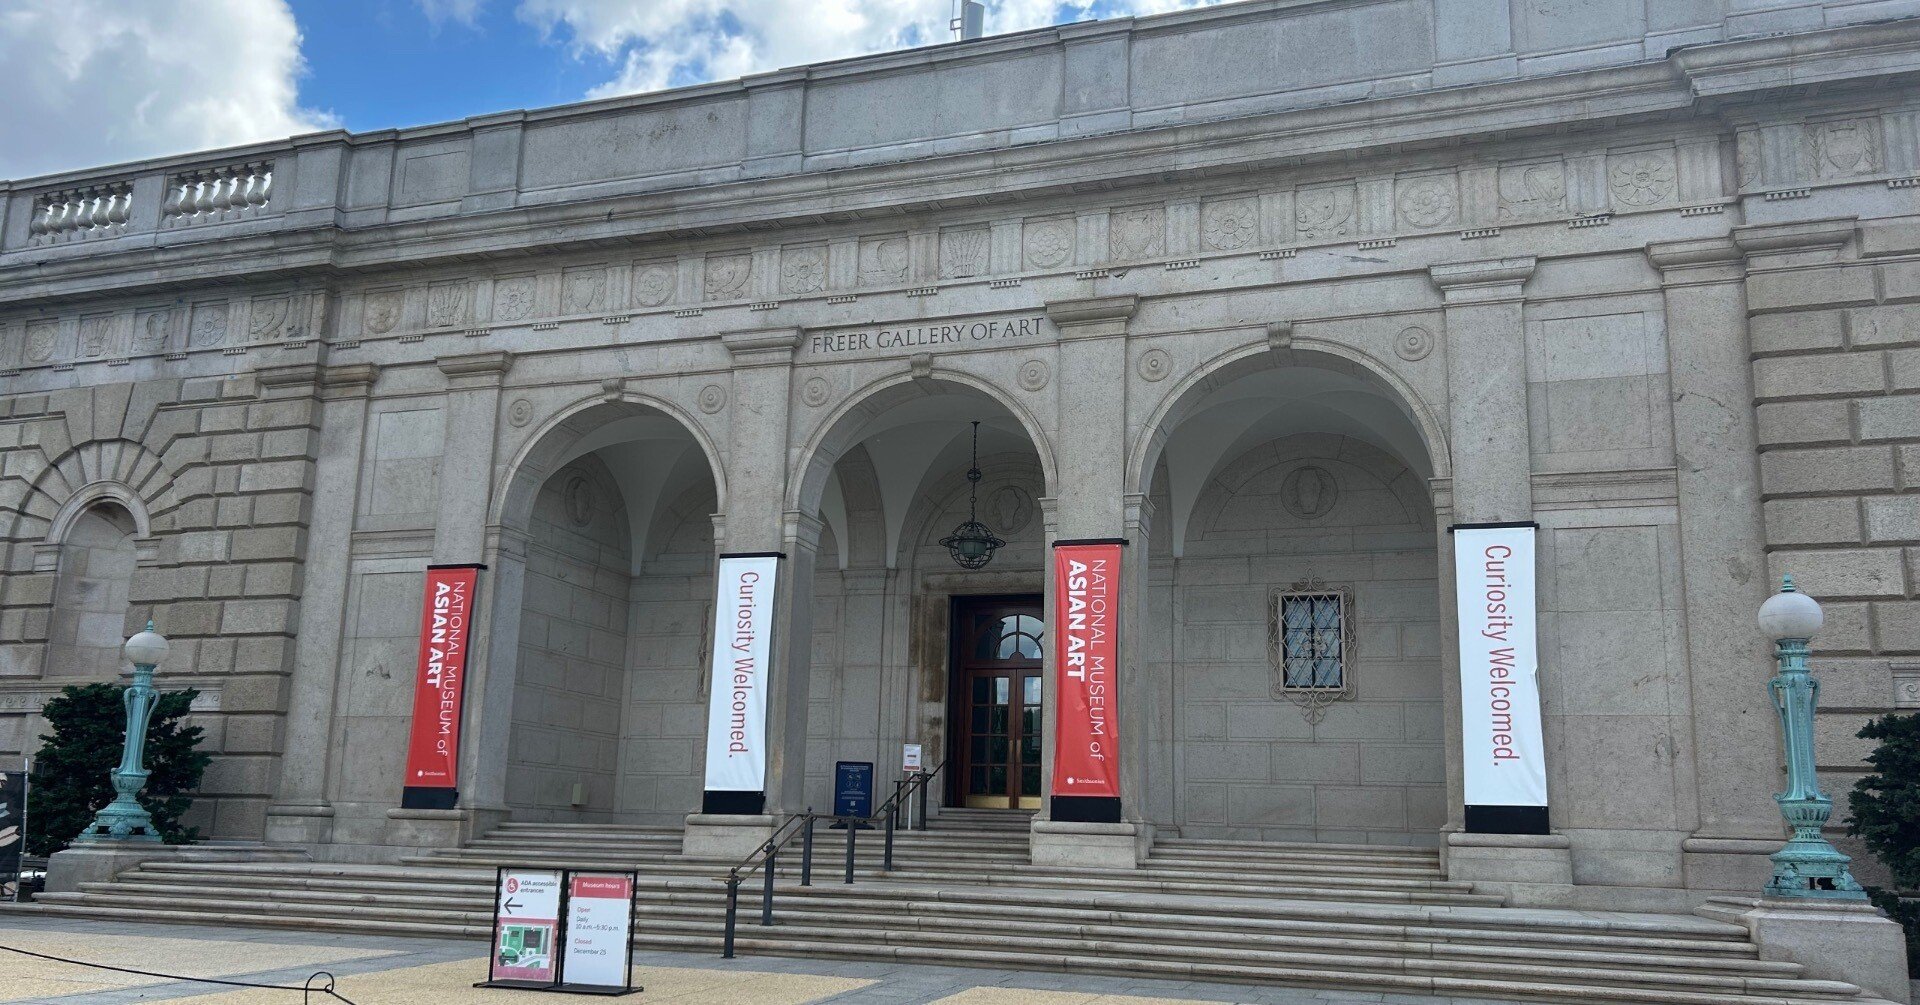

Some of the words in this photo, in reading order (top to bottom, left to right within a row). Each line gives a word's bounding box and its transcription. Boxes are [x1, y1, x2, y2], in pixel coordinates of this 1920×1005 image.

[812, 333, 871, 354] FREER
[876, 325, 966, 349] GALLERY
[970, 322, 998, 341] OF
[1002, 317, 1044, 338] ART
[431, 582, 451, 643] ASIAN
[446, 582, 466, 660] NATIONAL
[731, 572, 759, 653] Curiosity
[1068, 560, 1087, 630] ASIAN
[1090, 560, 1106, 650] NATIONAL
[1481, 545, 1513, 641] Curiosity
[427, 647, 444, 688] ART
[1067, 635, 1086, 682] ART
[438, 666, 458, 734] MUSEUM
[729, 658, 754, 758] Welcomed.
[1089, 656, 1105, 735] MUSEUM
[1488, 647, 1520, 766] Welcomed.
[437, 739, 448, 757] of
[1090, 741, 1104, 761] of
